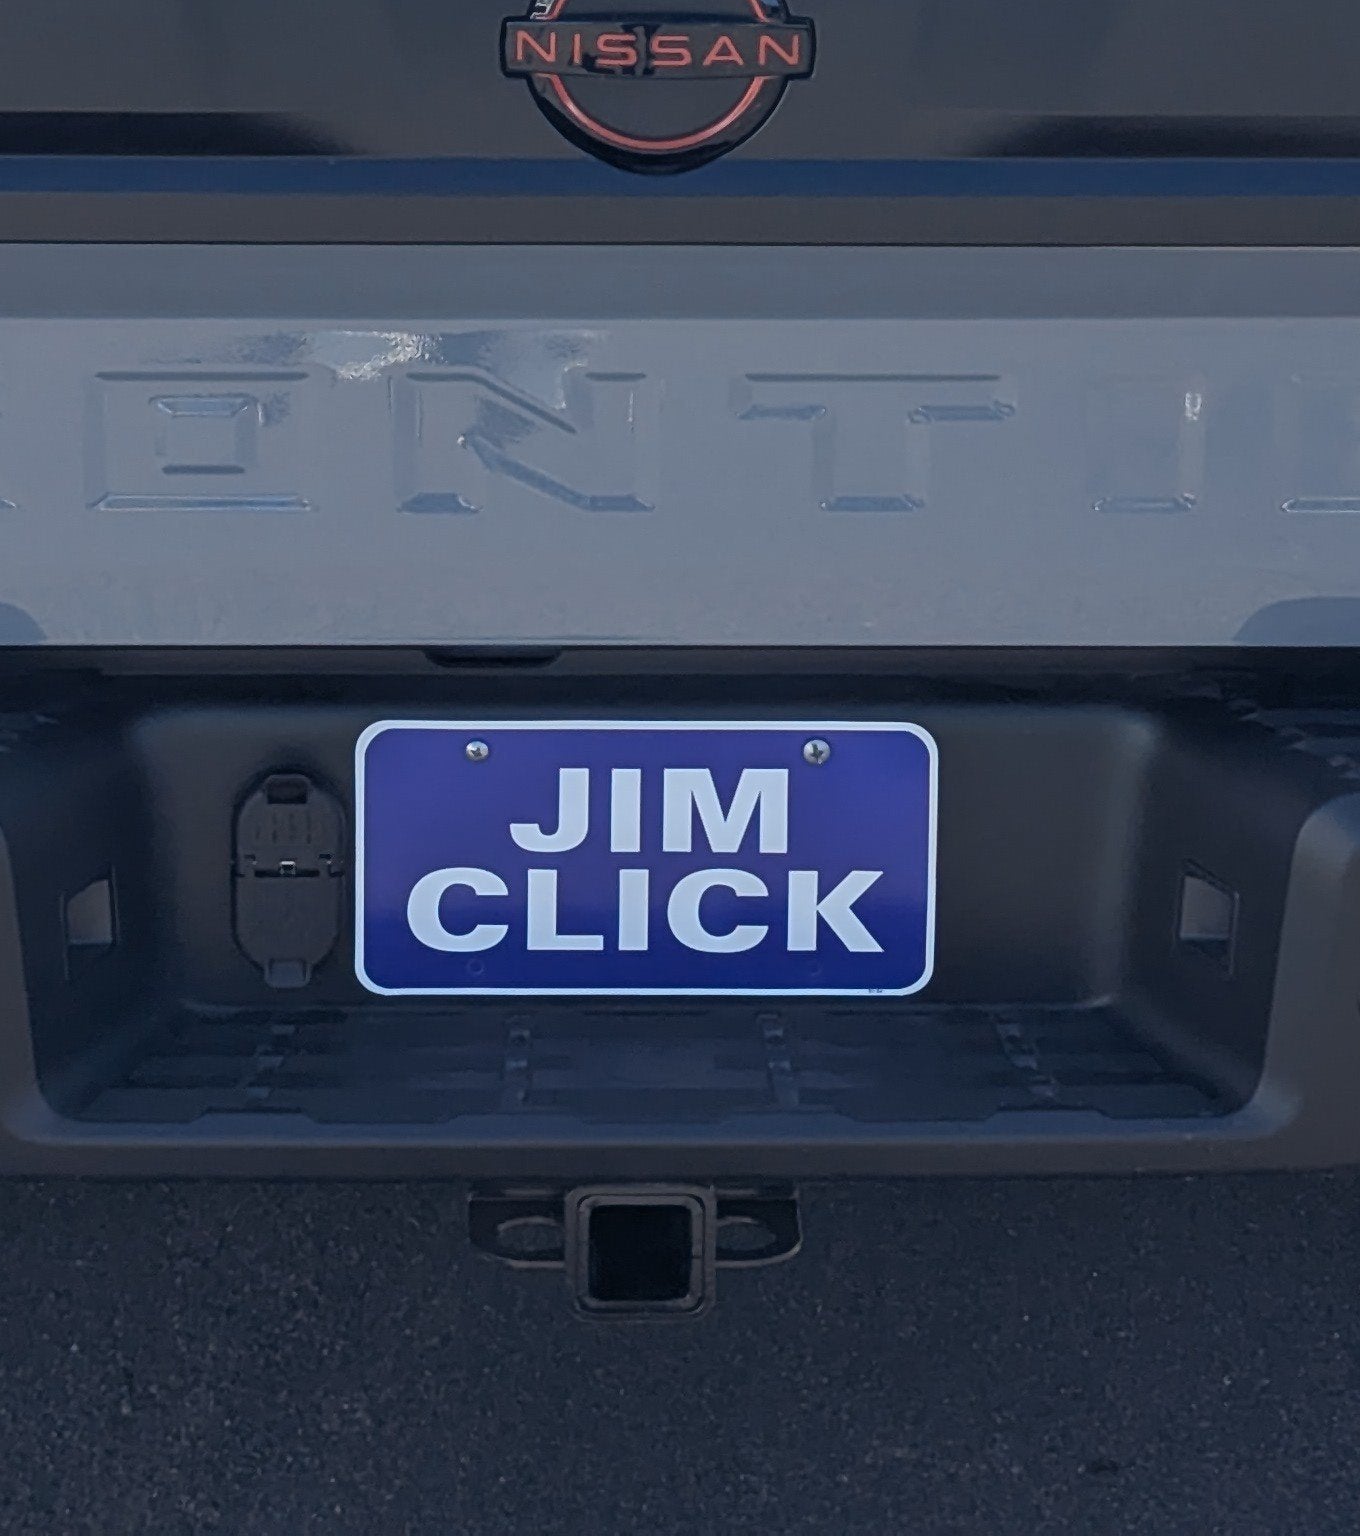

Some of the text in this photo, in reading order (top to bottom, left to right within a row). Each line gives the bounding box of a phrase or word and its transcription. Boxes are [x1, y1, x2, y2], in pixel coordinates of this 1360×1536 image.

[514, 30, 802, 66] NISSAN
[510, 767, 789, 853] JIM
[406, 867, 886, 952] CLICK
